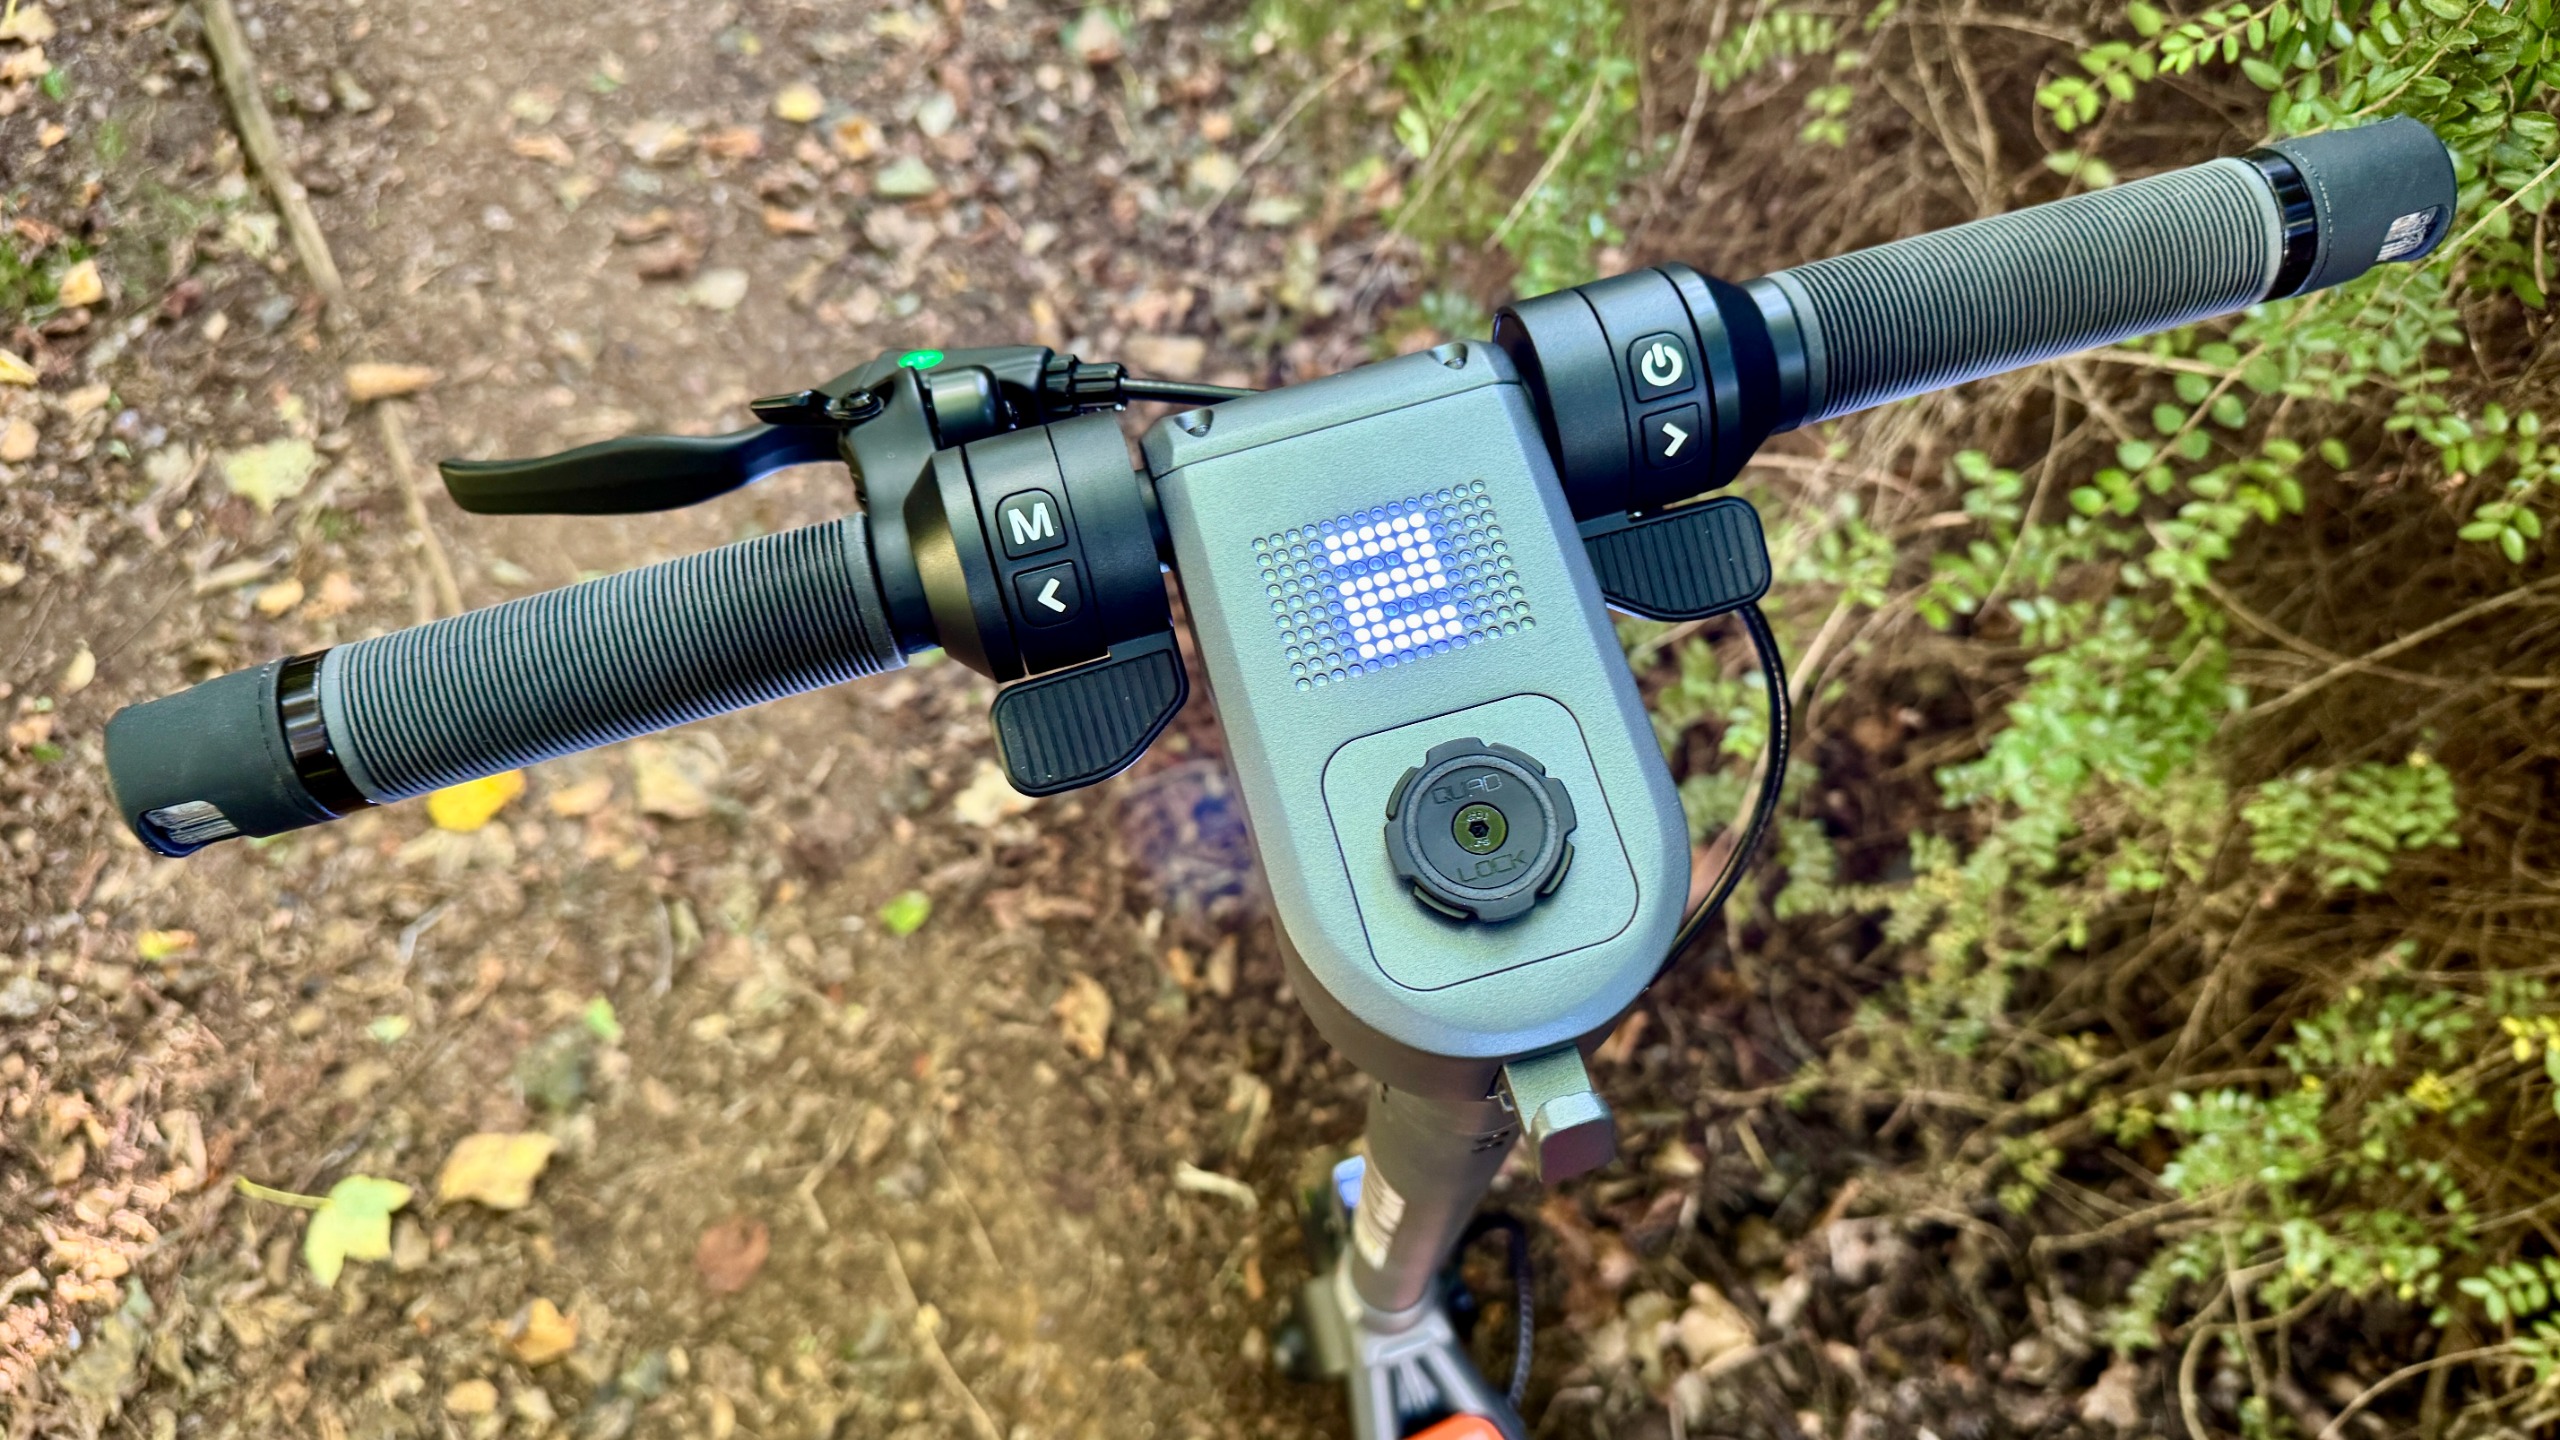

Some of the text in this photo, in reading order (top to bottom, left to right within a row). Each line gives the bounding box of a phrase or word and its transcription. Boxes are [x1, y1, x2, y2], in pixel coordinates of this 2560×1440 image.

[1007, 502, 1055, 545] M
[1324, 512, 1463, 659] 2
[1432, 773, 1502, 804] QUAD
[1459, 851, 1526, 882] LOCK
